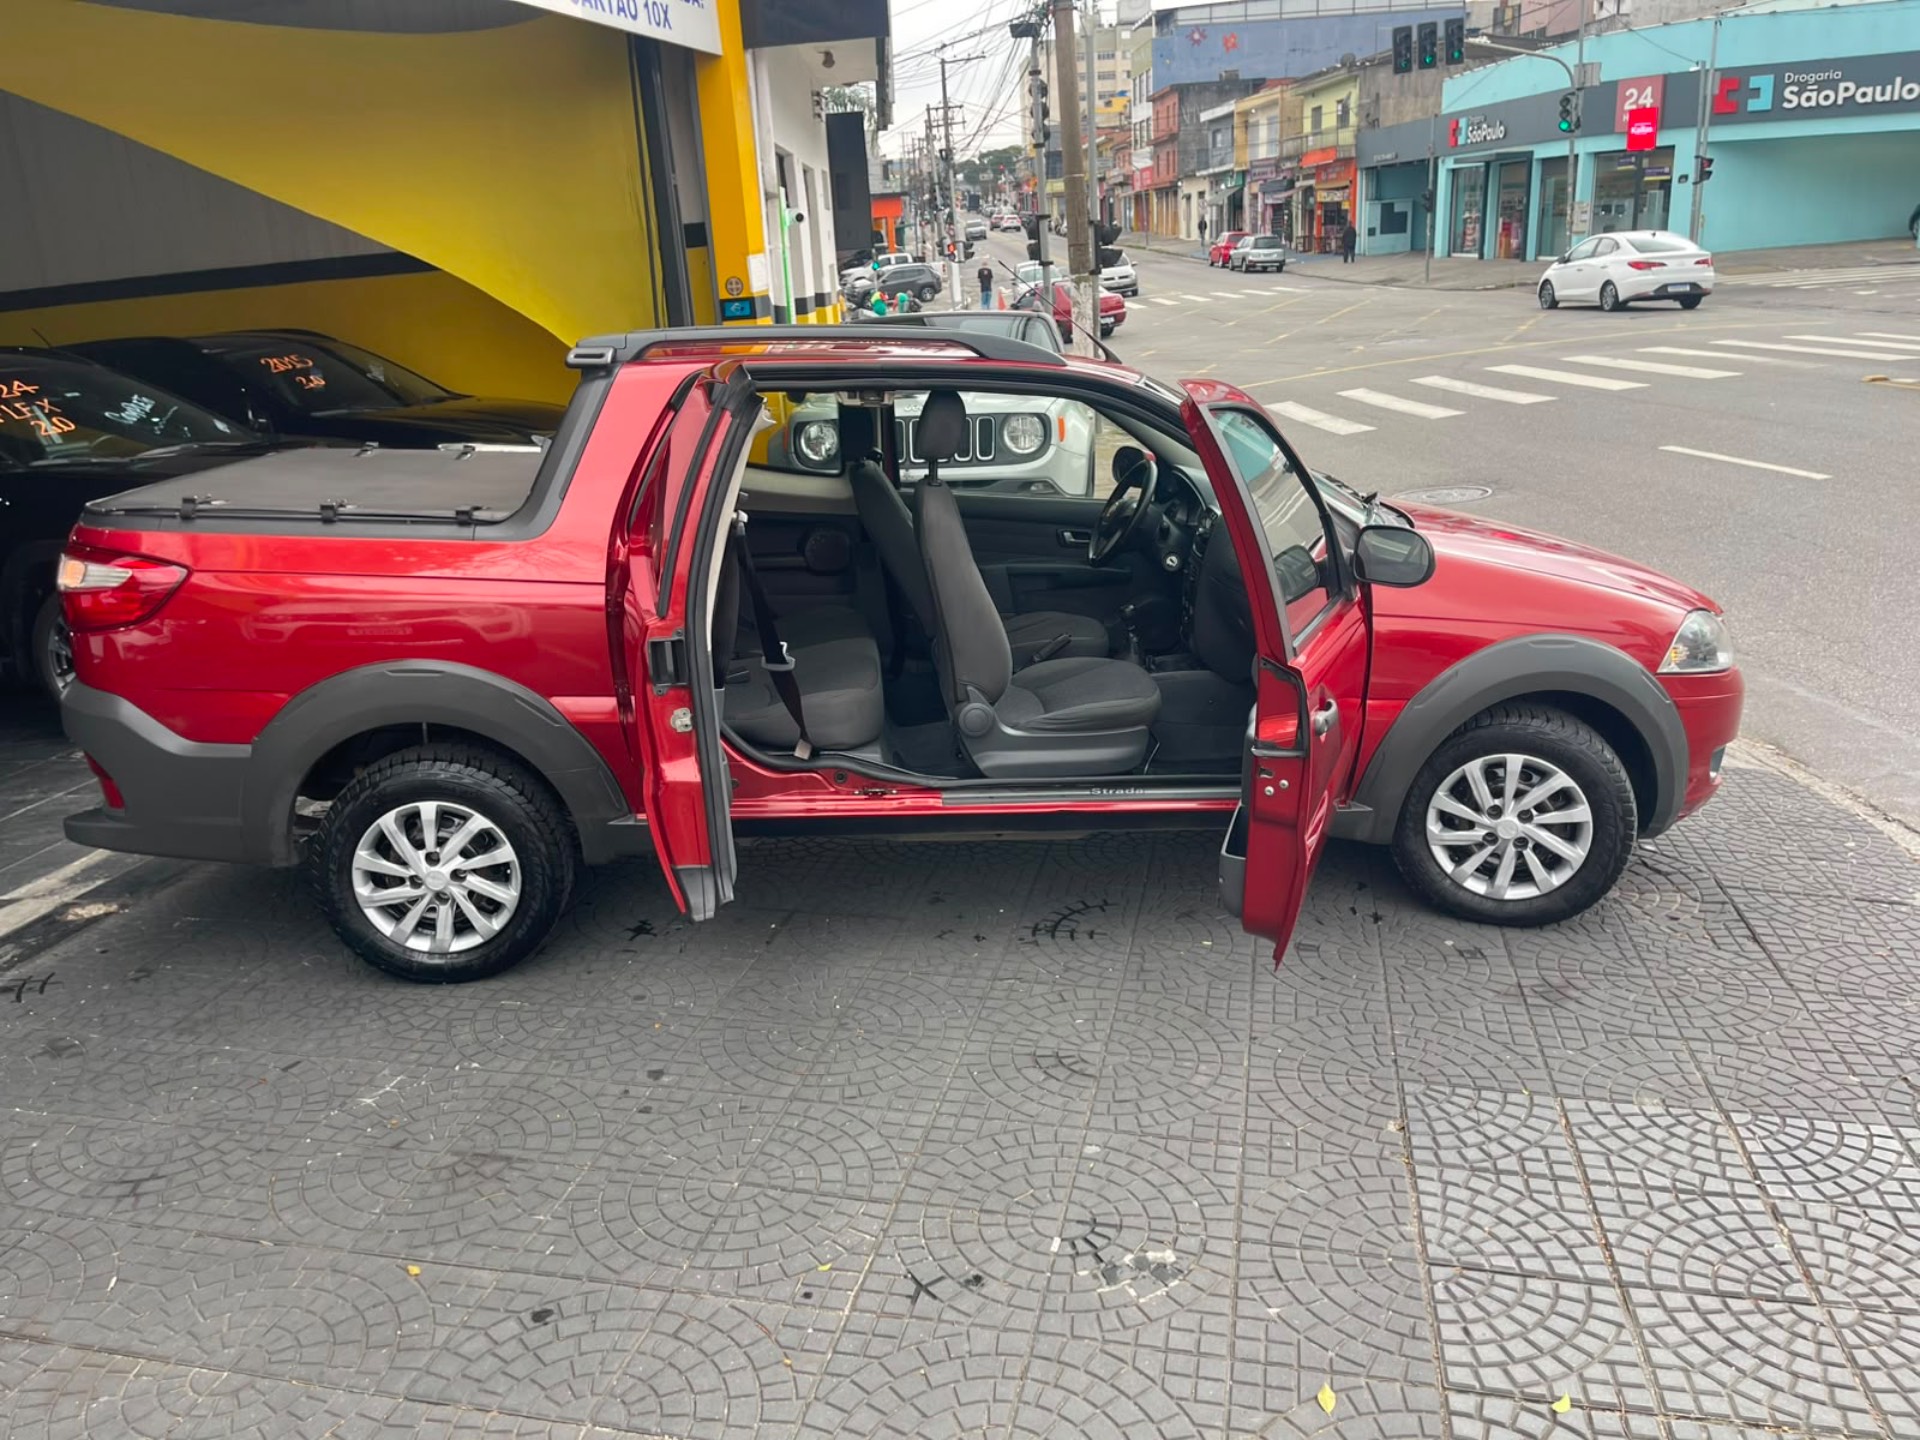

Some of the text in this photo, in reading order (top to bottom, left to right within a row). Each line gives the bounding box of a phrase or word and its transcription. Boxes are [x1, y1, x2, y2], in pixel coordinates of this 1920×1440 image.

[643, 0, 673, 30] 10X
[1784, 69, 1842, 84] Drogaria
[1623, 85, 1654, 110] 24
[1782, 76, 1920, 109] SãoPaulo
[0, 397, 62, 423] LEX
